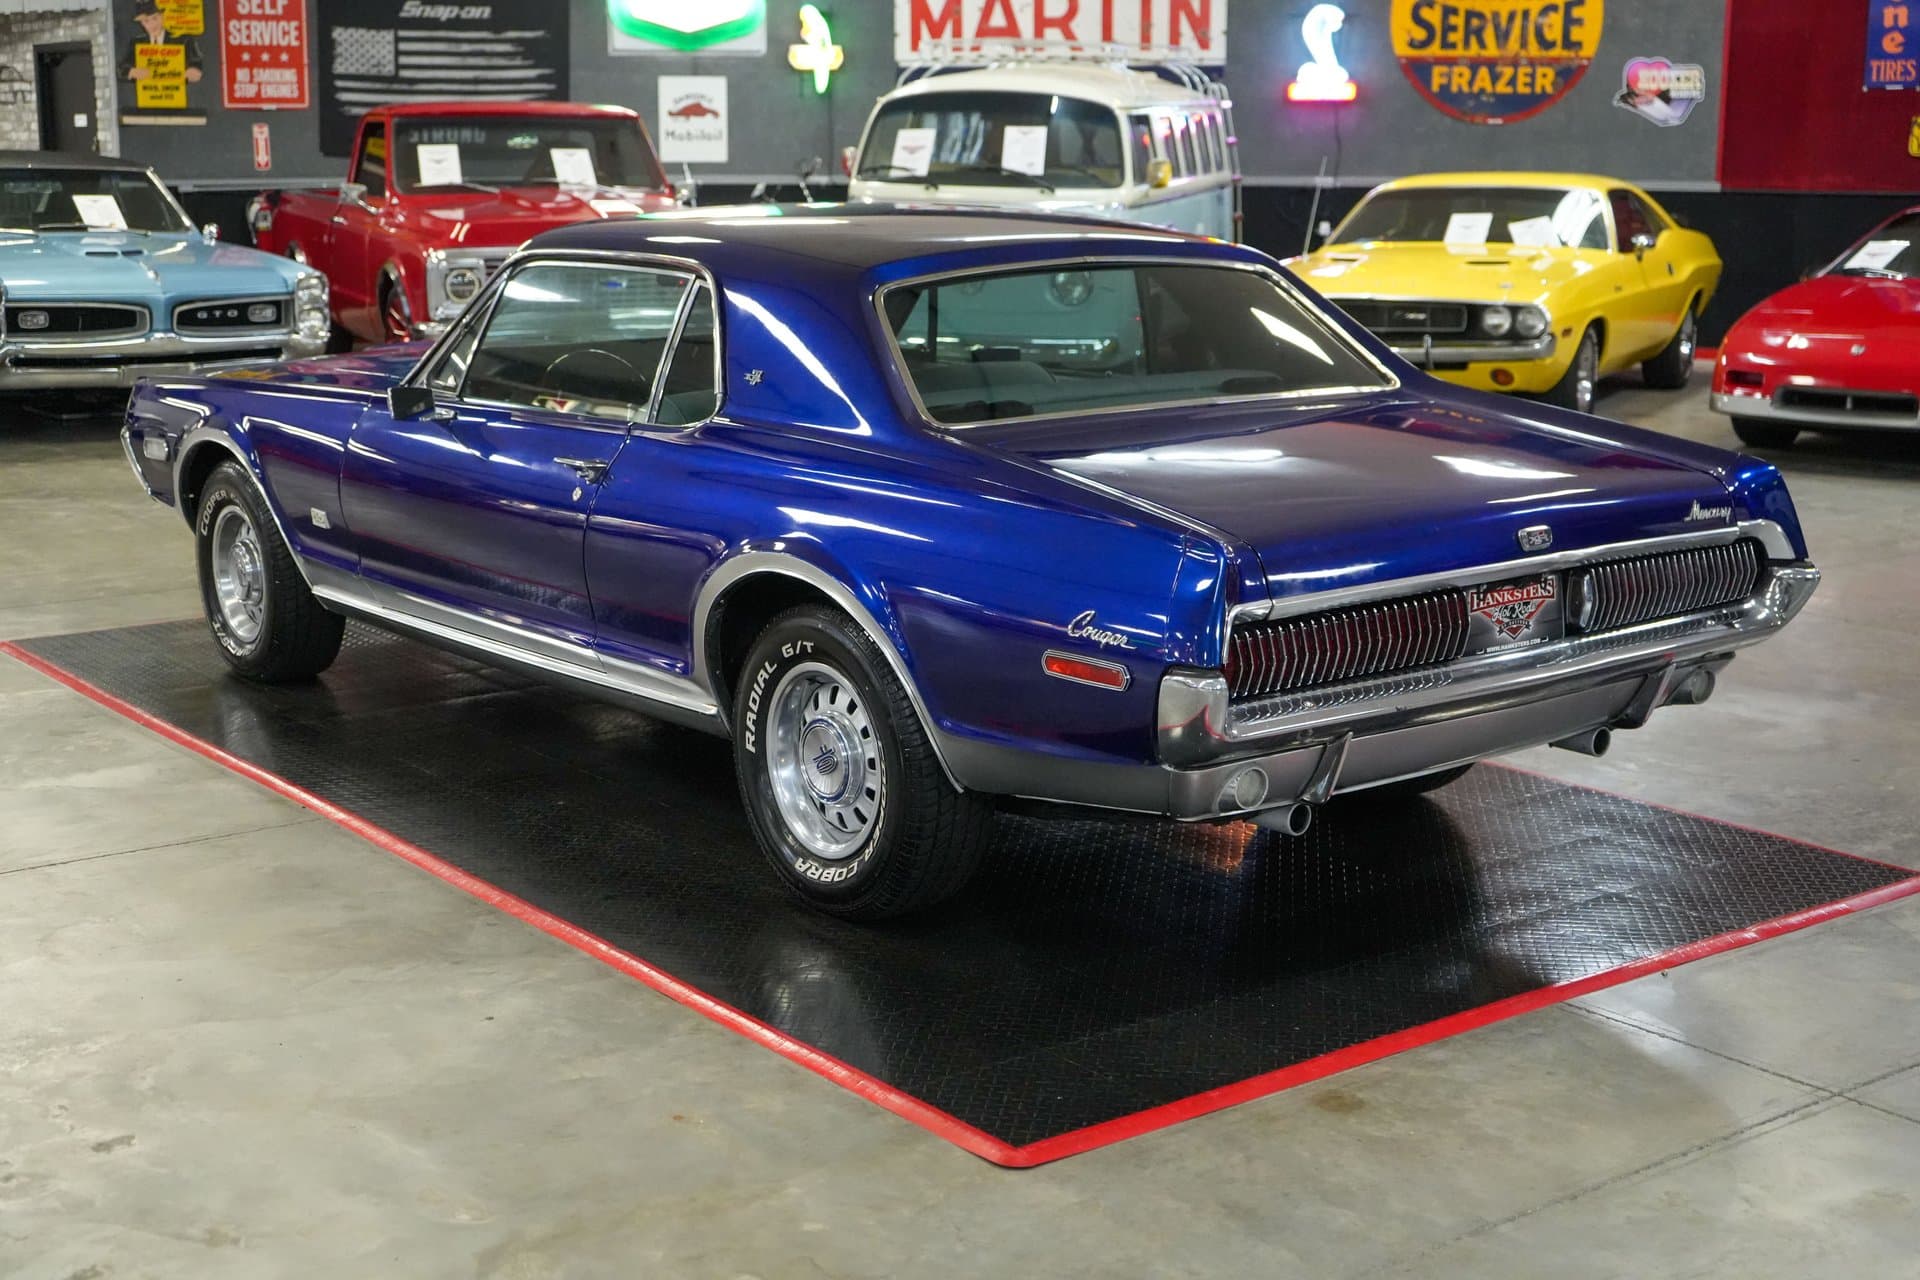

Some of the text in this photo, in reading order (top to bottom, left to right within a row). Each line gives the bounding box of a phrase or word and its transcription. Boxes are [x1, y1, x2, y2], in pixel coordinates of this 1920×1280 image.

[236, 0, 288, 15] SELF
[399, 0, 492, 21] Snap-on
[228, 19, 300, 47] SERVICE
[1408, 0, 1586, 50] SERVICE
[236, 68, 298, 83] NO SMOKING
[1431, 65, 1556, 95] FRAZER
[1870, 59, 1917, 82] TIRES
[234, 83, 299, 98] STOP ENGINES
[197, 308, 239, 319] GTO
[201, 490, 227, 537] COOPER
[1684, 499, 1732, 523] Mercury
[1472, 580, 1554, 611] HANKSTERS
[1067, 610, 1138, 649] Cougar
[745, 640, 815, 754] RADIAL G/T
[794, 857, 859, 881] COBRA
